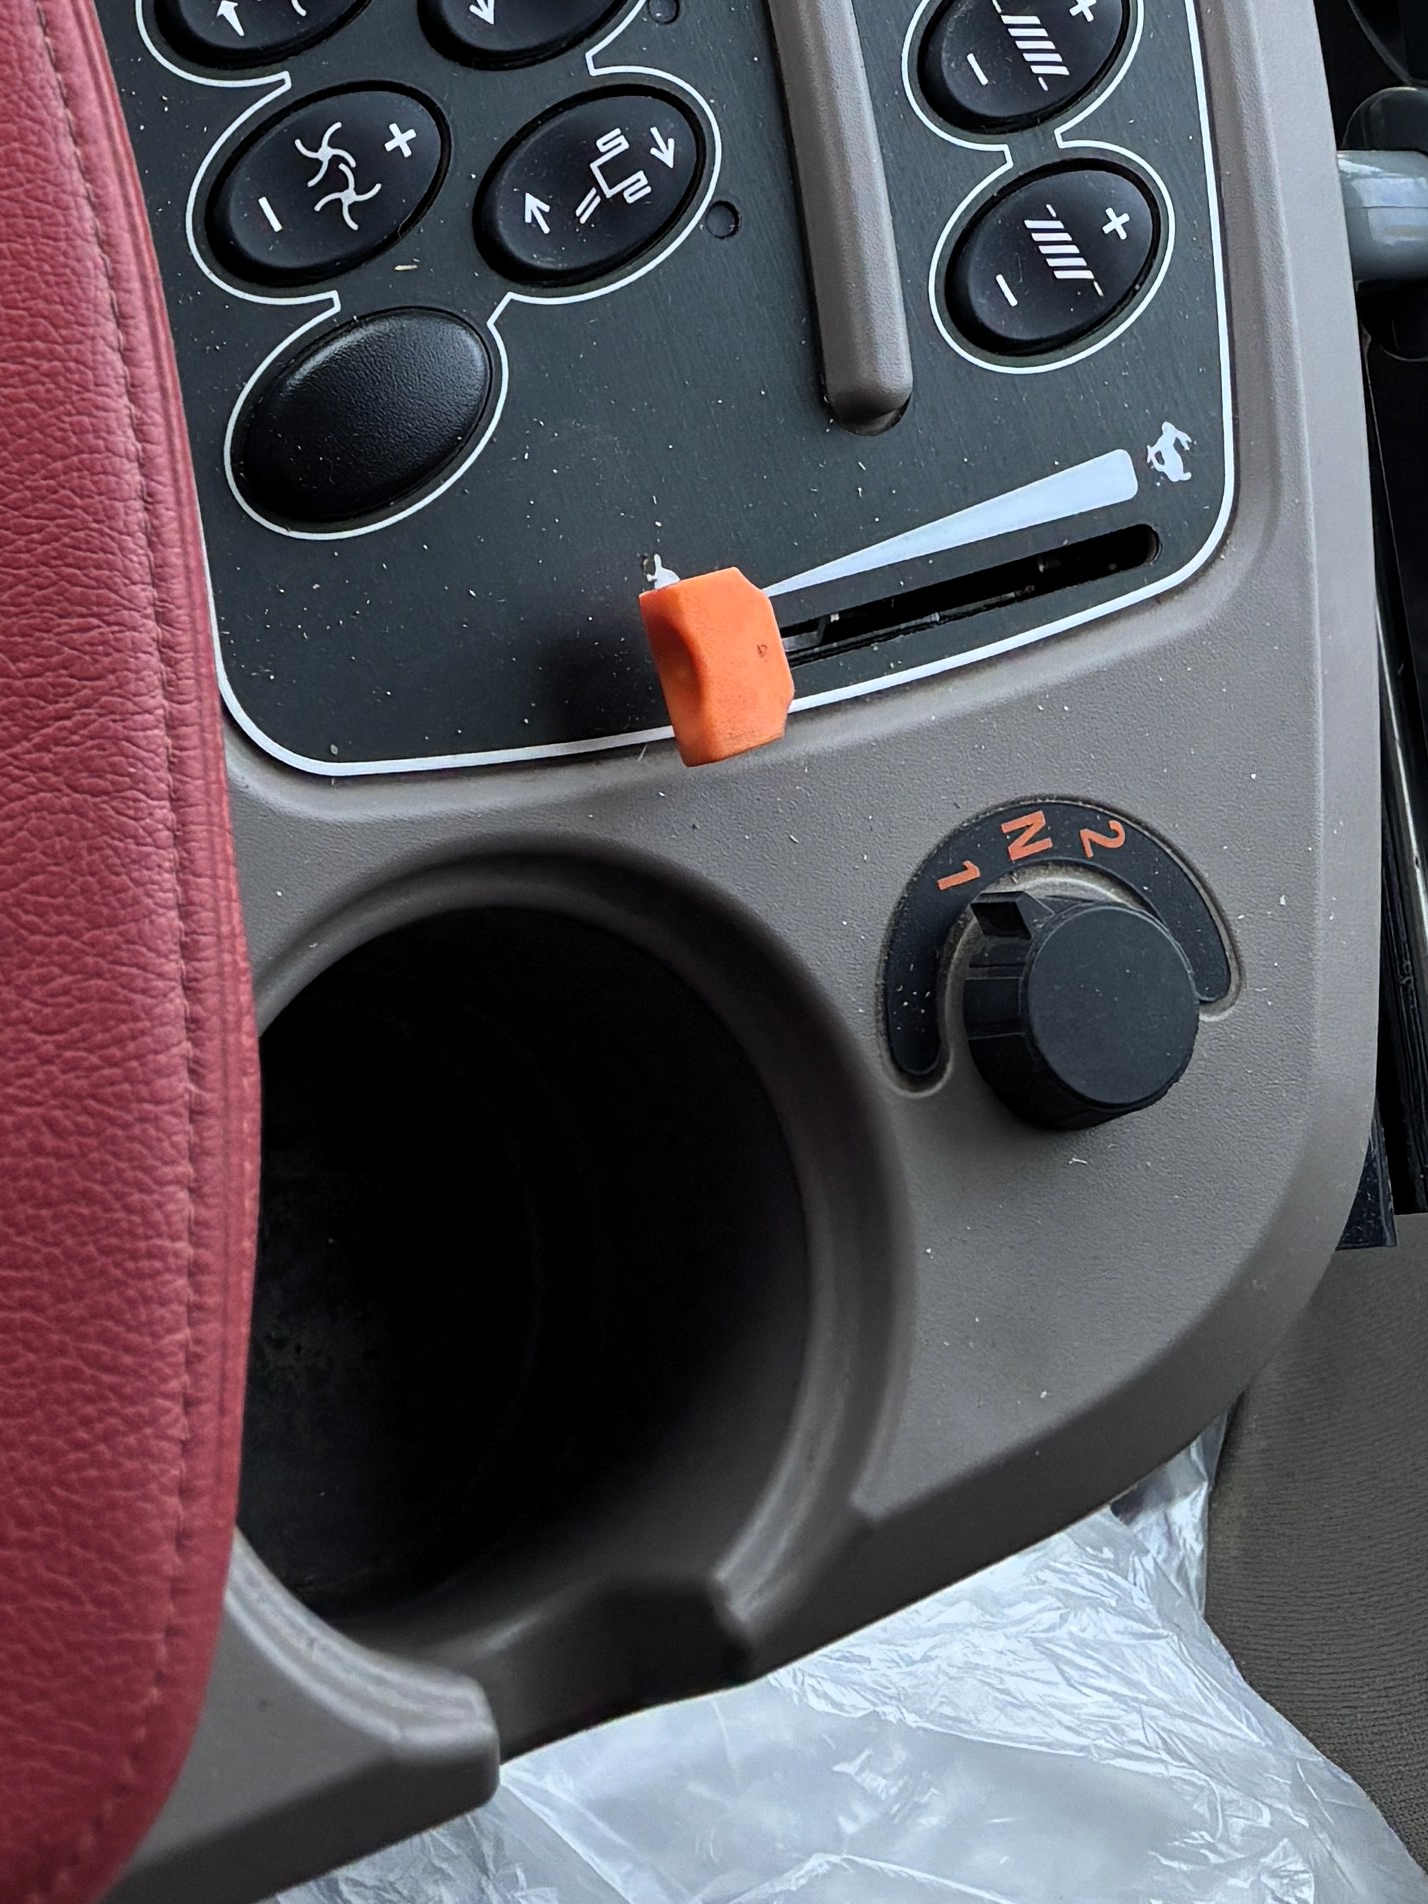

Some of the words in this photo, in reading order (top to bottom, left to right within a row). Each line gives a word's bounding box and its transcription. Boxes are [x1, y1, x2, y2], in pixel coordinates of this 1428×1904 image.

[937, 860, 981, 891] 1
[1001, 809, 1054, 862] N
[1079, 819, 1127, 859] 2
